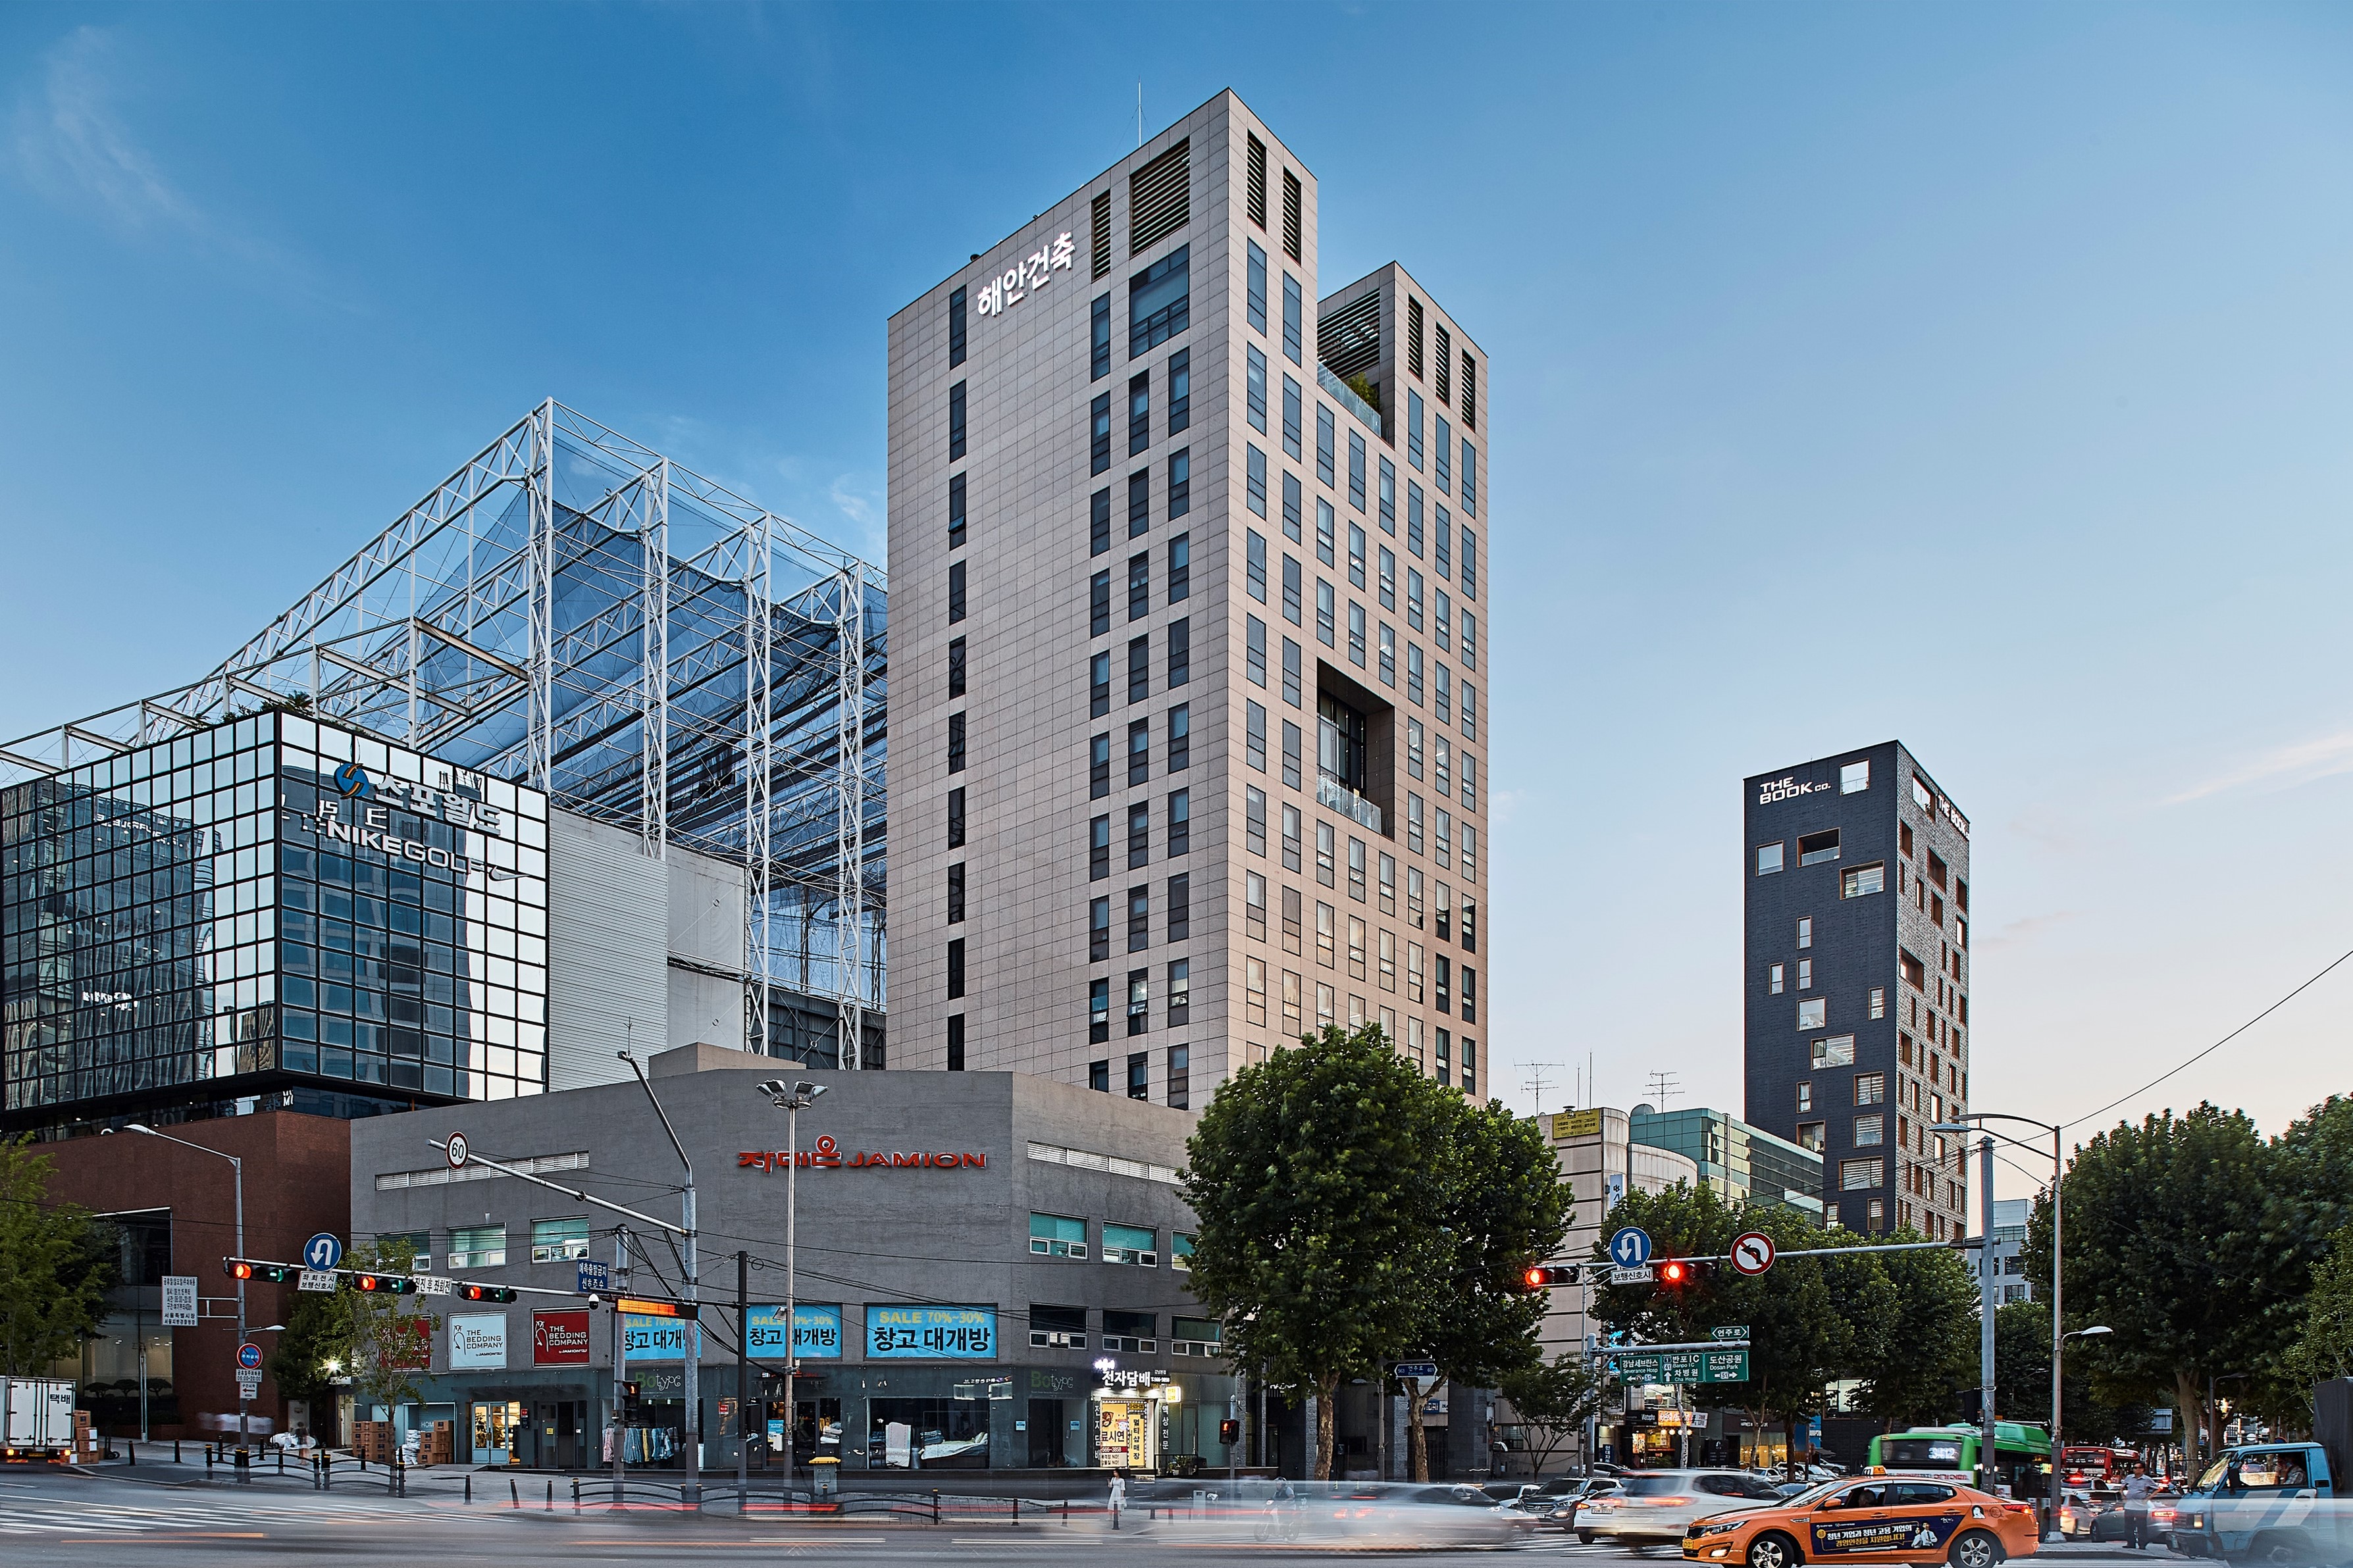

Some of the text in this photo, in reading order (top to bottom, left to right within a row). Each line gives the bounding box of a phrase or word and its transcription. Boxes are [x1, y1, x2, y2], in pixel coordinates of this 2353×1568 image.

[977, 232, 1075, 317] 해안건축
[1759, 776, 1794, 792] THE
[1759, 781, 1813, 805] BOOK
[375, 775, 501, 836] 스포월드
[1938, 794, 1967, 836] THE BOOK
[452, 1142, 465, 1159] 60
[738, 1135, 986, 1173] 자미온 JAMION
[1613, 1271, 1651, 1282] 보행신호시
[300, 1281, 334, 1290] 보행신호시
[626, 1317, 652, 1328] SALE
[794, 1316, 834, 1325] 0%~30%
[879, 1311, 985, 1324] SALE 70%~30%
[749, 1328, 783, 1346] 창고
[1717, 1328, 1742, 1337] 언주로
[549, 1338, 588, 1347] COMPANY
[625, 1329, 686, 1351] 창고 대개
[873, 1327, 991, 1352] 창고 대개방
[1622, 1358, 1659, 1369] 강남세브란스
[1672, 1354, 1700, 1364] 반포 IC
[1709, 1354, 1743, 1365] 도산공원
[1102, 1370, 1151, 1387] 전자담배
[1674, 1368, 1699, 1377] 차병원
[49, 1394, 71, 1405] 택배
